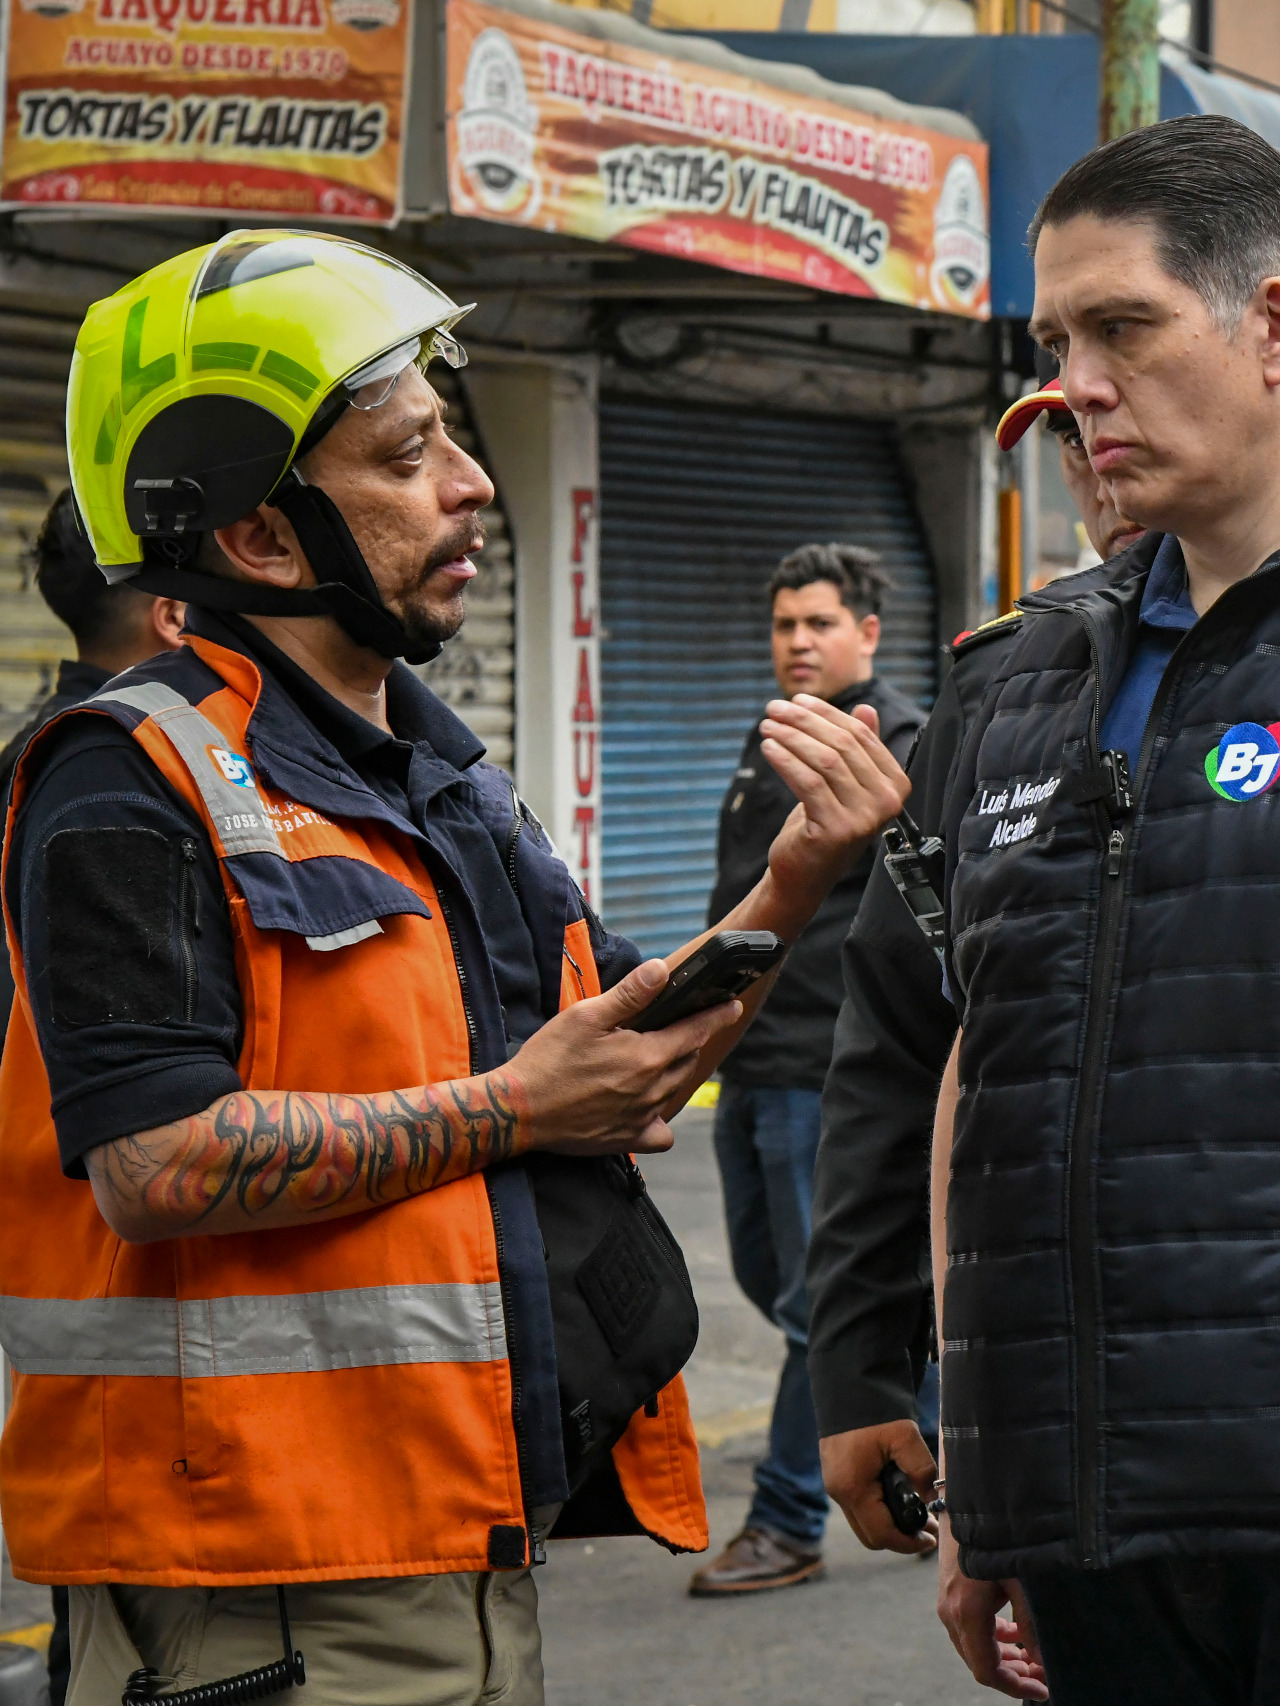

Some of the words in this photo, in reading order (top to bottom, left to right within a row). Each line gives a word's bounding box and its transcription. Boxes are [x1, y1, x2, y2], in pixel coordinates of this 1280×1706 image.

[65, 39, 175, 67] AGUAYO
[181, 42, 269, 72] DESDE
[22, 95, 170, 141] TORTAS
[177, 102, 209, 145] Y
[210, 101, 386, 156] FLAUTAS
[795, 115, 875, 172] DESDE
[736, 163, 758, 210] Y
[759, 170, 884, 267] FLAUTAS
[211, 749, 256, 788] BJ
[1214, 742, 1280, 794] BJ
[978, 788, 1010, 816] Luis
[224, 813, 259, 831] JOSE
[988, 811, 1038, 849] Alcalde
